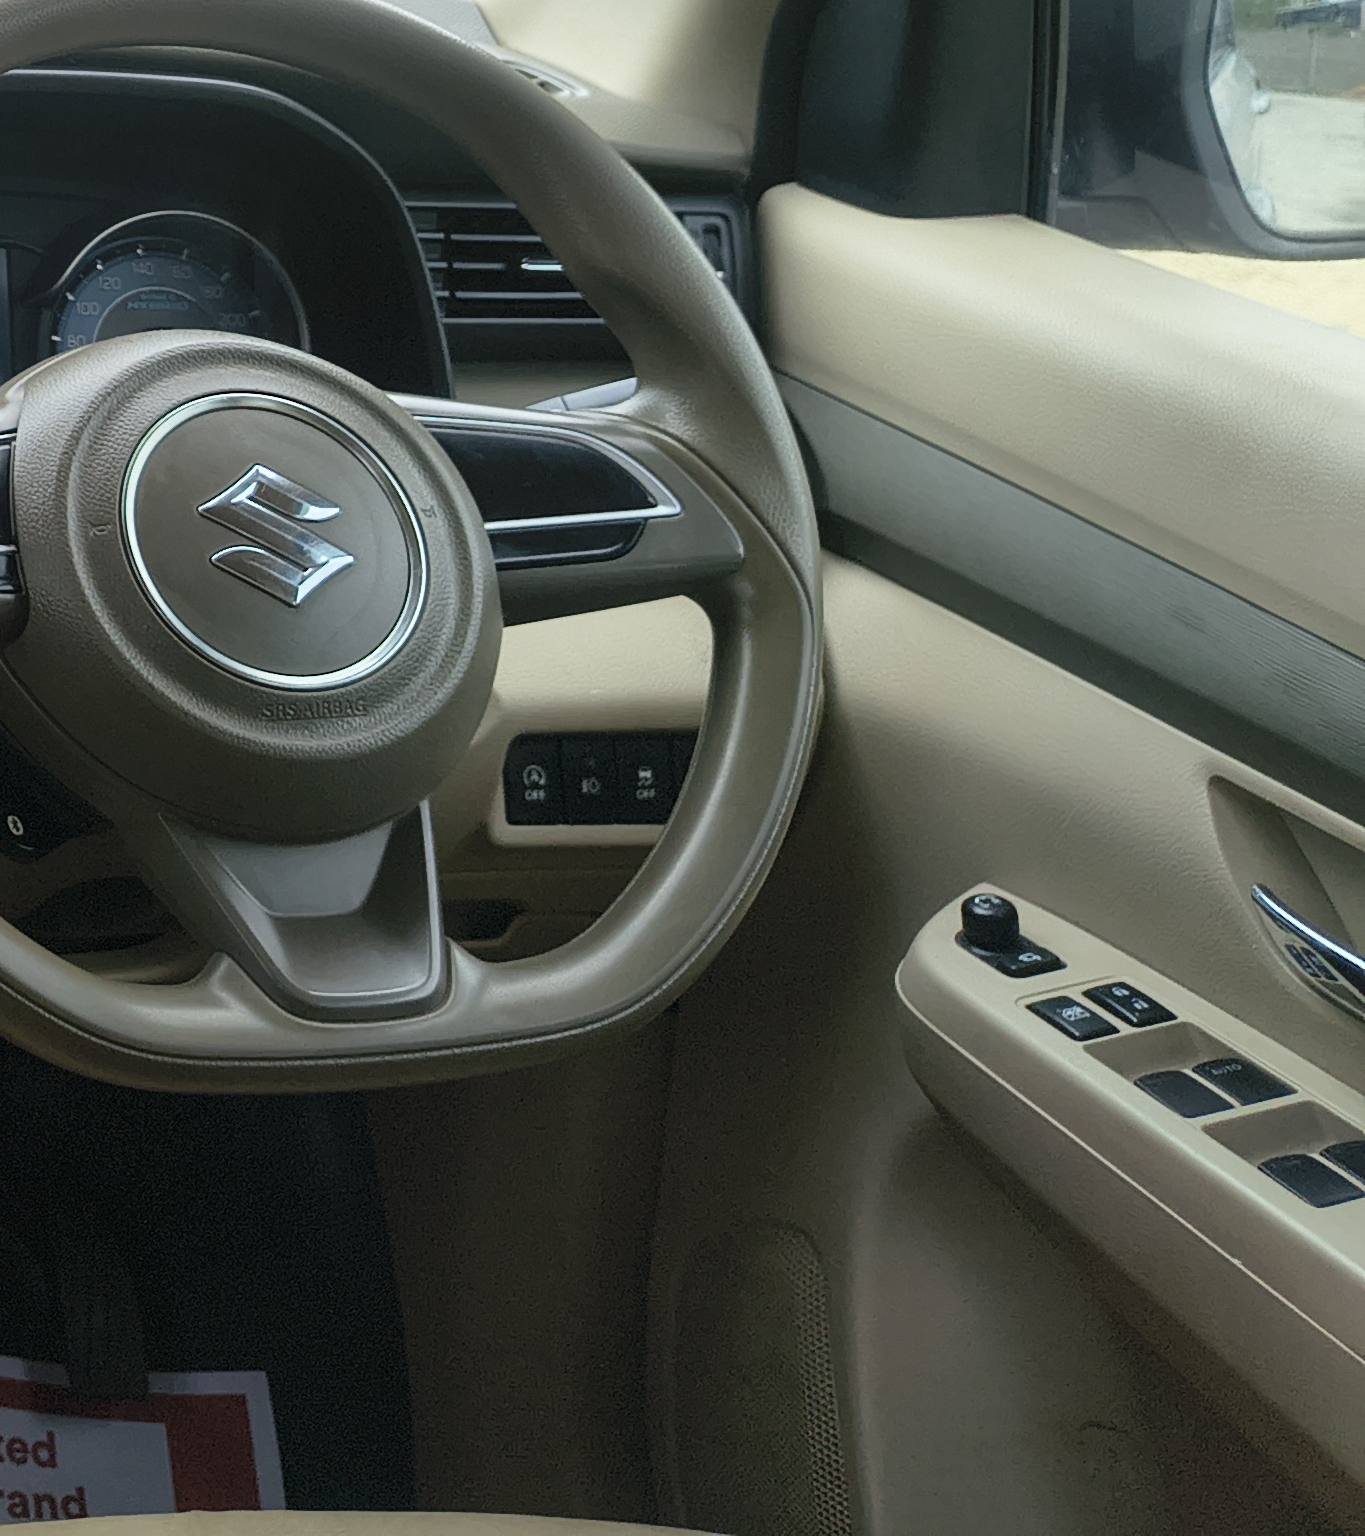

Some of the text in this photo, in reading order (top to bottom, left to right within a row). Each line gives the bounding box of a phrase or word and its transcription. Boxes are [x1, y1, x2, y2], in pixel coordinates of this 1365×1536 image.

[98, 276, 121, 290] 120
[76, 302, 100, 315] 100
[262, 699, 367, 720] SRS AIRBAG
